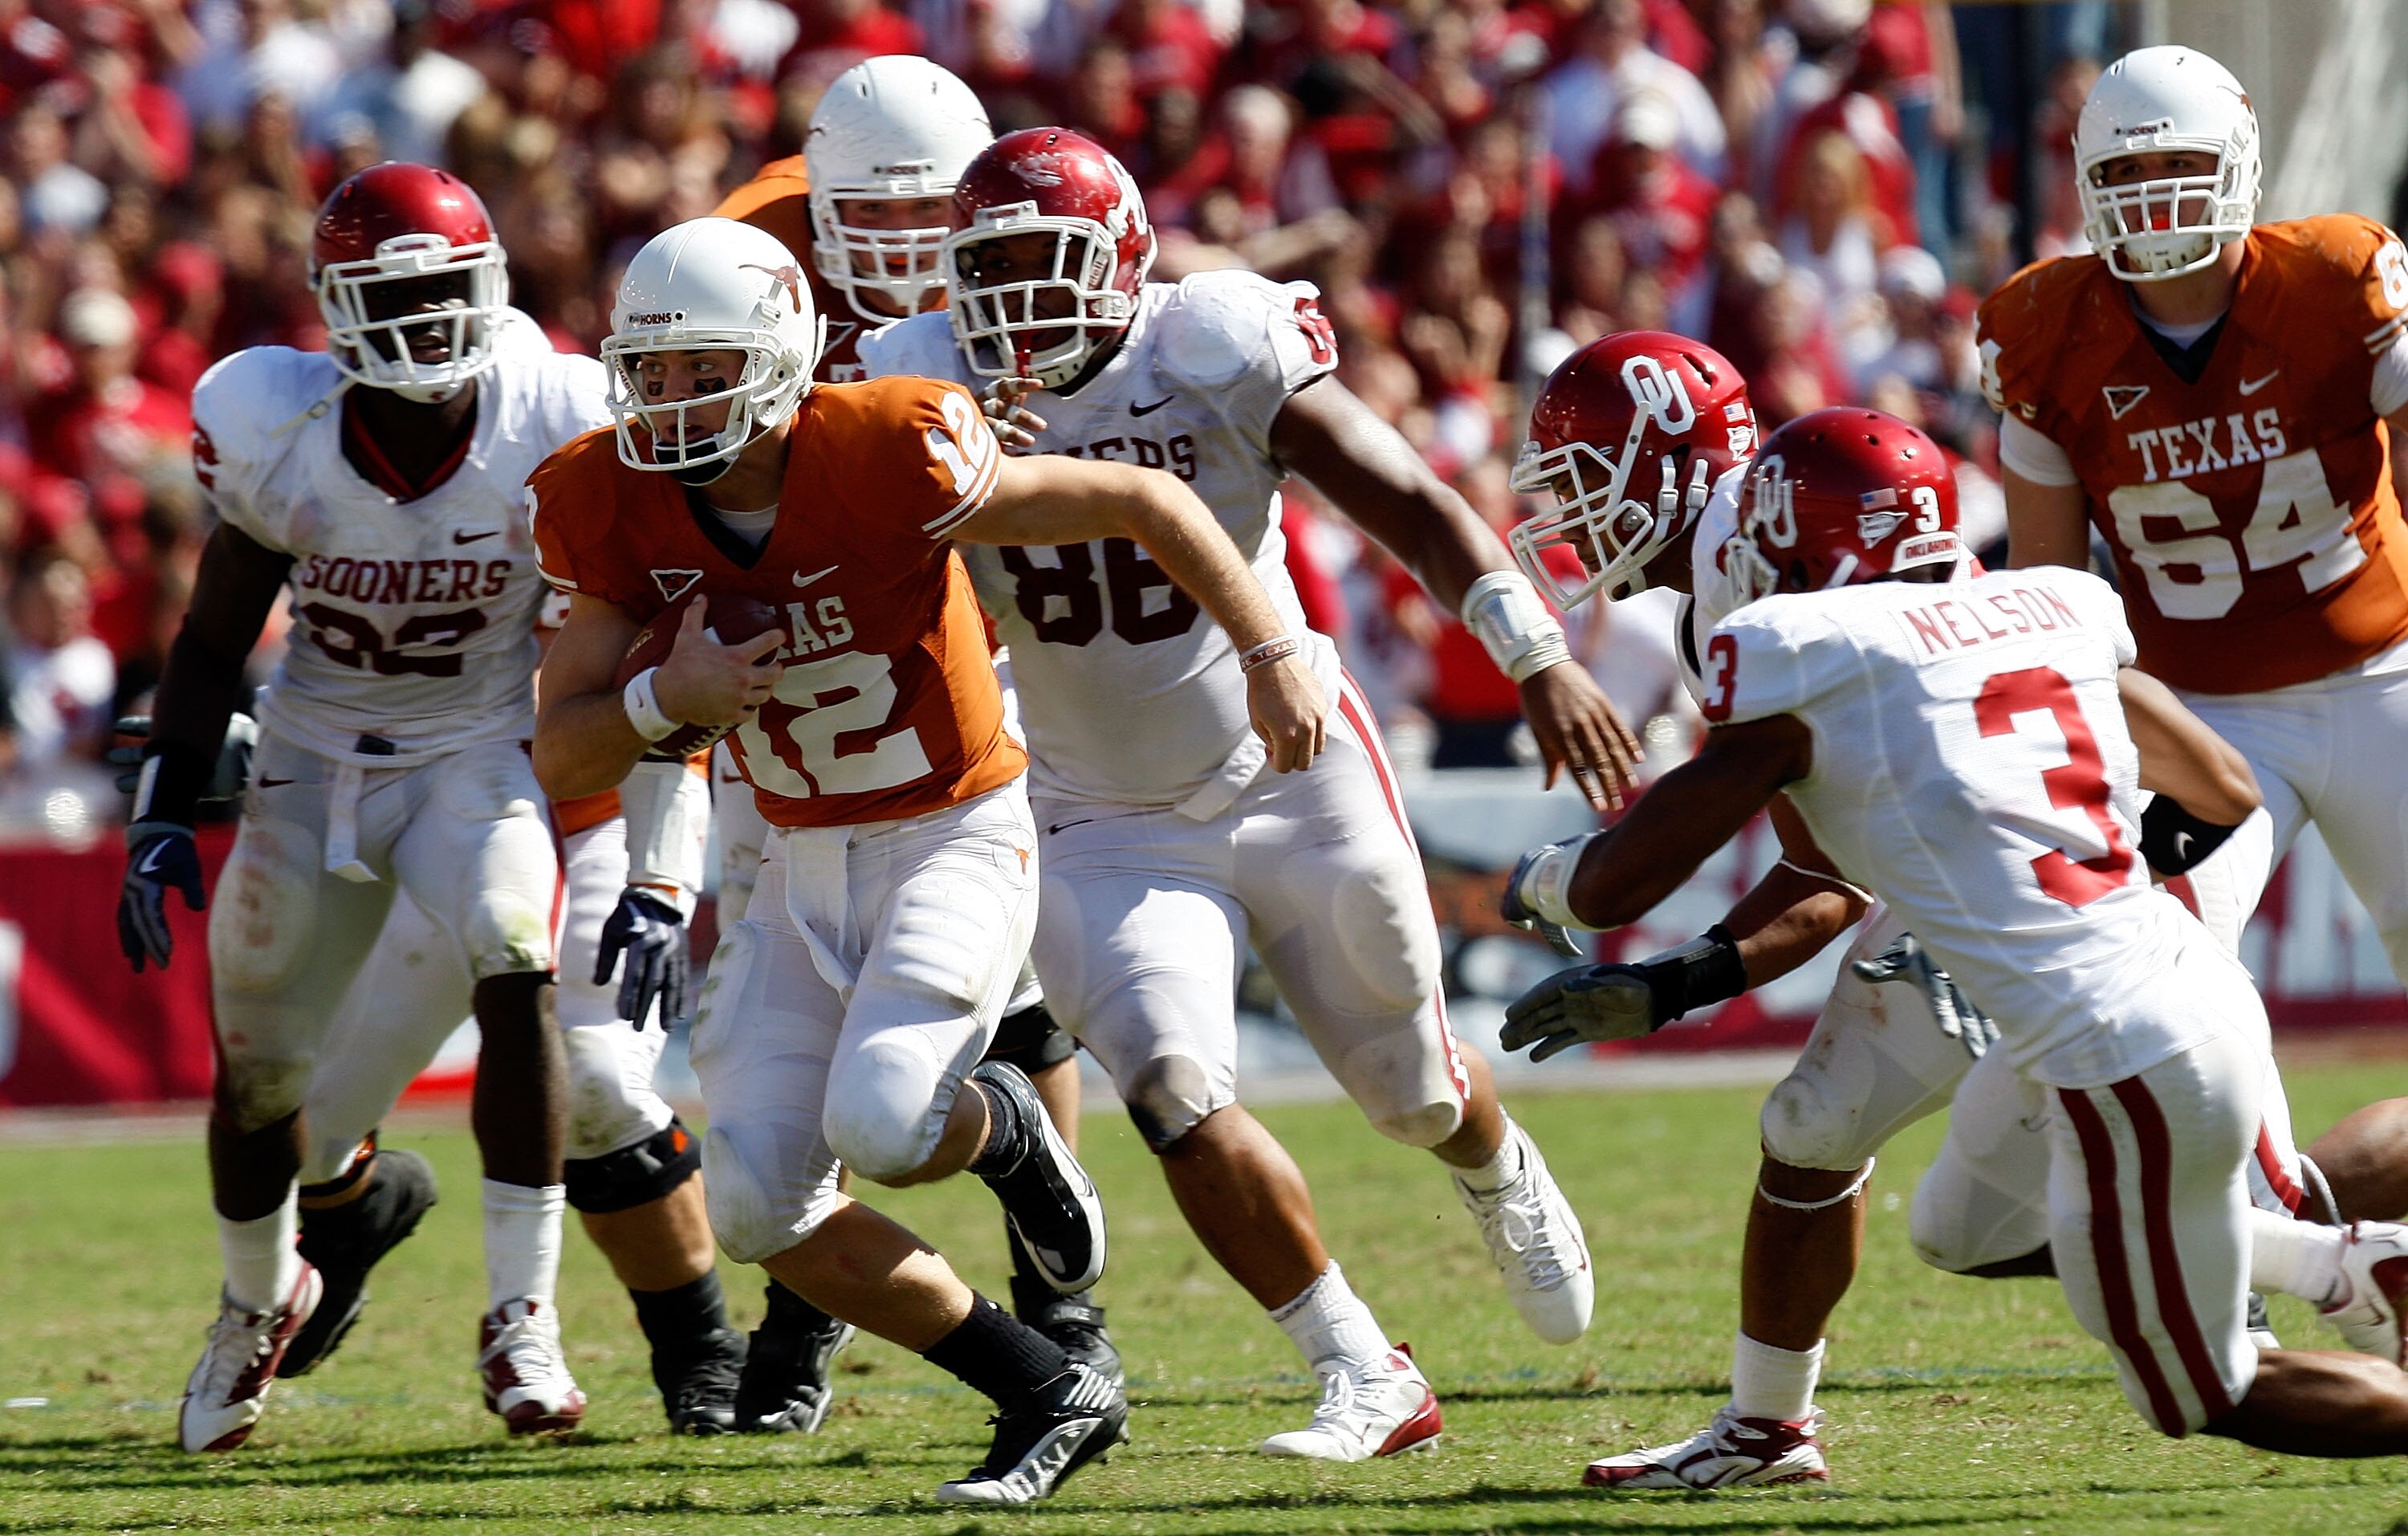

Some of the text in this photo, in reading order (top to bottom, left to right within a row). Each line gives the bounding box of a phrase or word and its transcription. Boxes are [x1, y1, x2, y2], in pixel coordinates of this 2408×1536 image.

[1620, 355, 1696, 436] OU
[925, 391, 990, 496] 12
[2128, 408, 2288, 482] TEXAS
[1911, 486, 1942, 533] 3
[2107, 446, 2368, 621] 64
[299, 553, 512, 605] SOONERS
[999, 536, 1201, 647] 86
[1903, 586, 2083, 655] NELSON
[301, 602, 487, 677] 92
[1702, 634, 1739, 722] 3
[736, 650, 934, 799] 12
[1973, 665, 2134, 908] 3
